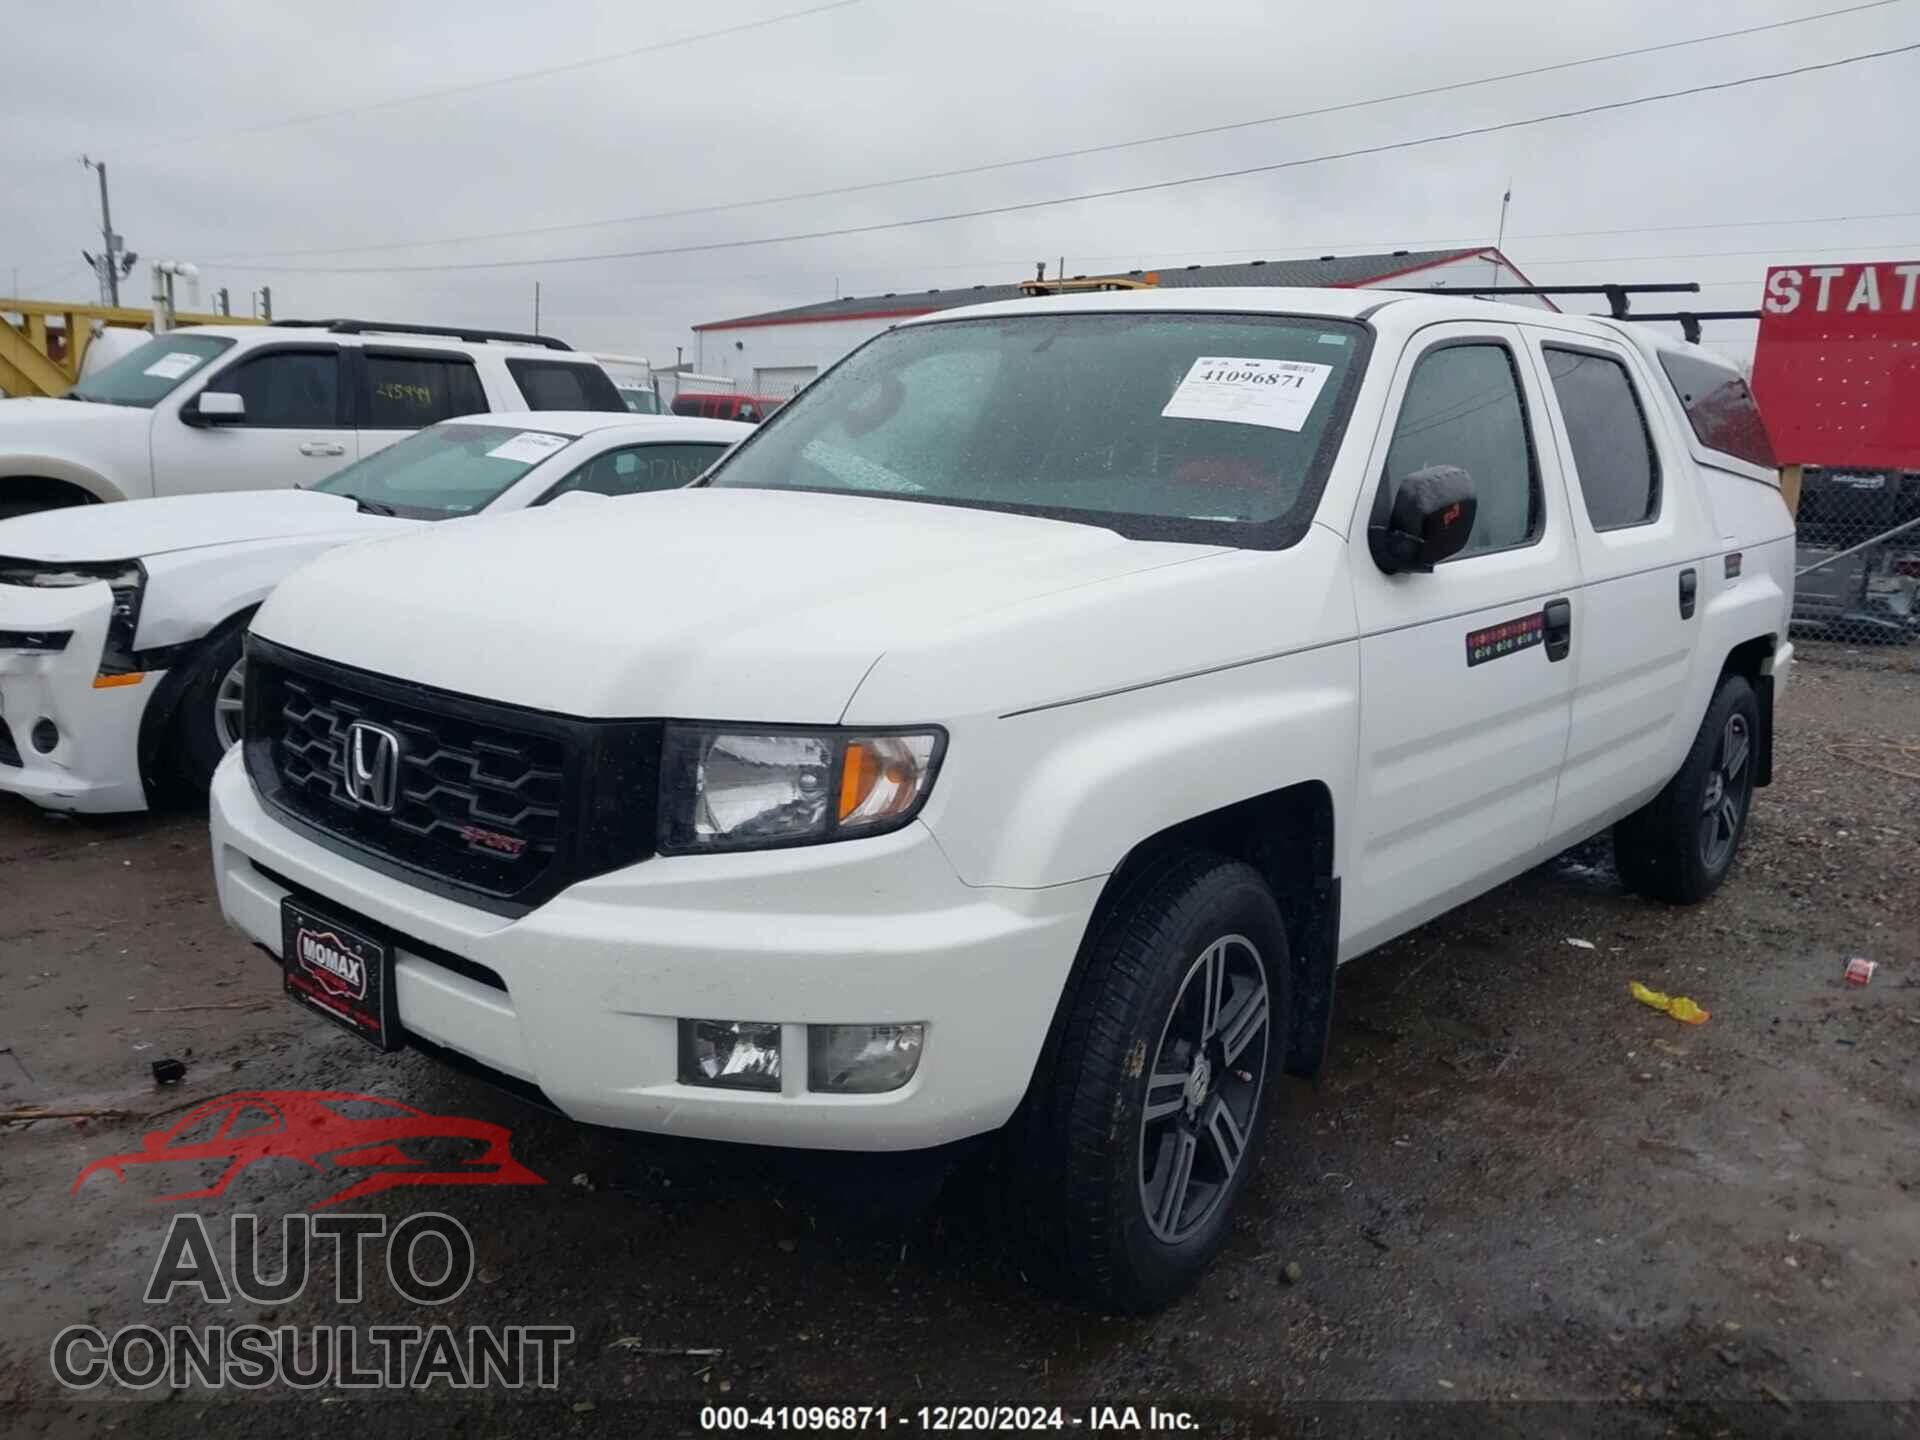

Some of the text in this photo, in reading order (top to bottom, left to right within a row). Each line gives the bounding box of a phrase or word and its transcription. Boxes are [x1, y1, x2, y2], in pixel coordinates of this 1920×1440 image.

[1200, 369, 1304, 388] 41096871
[462, 825, 527, 857] SPORT
[303, 936, 361, 983] MOMAX
